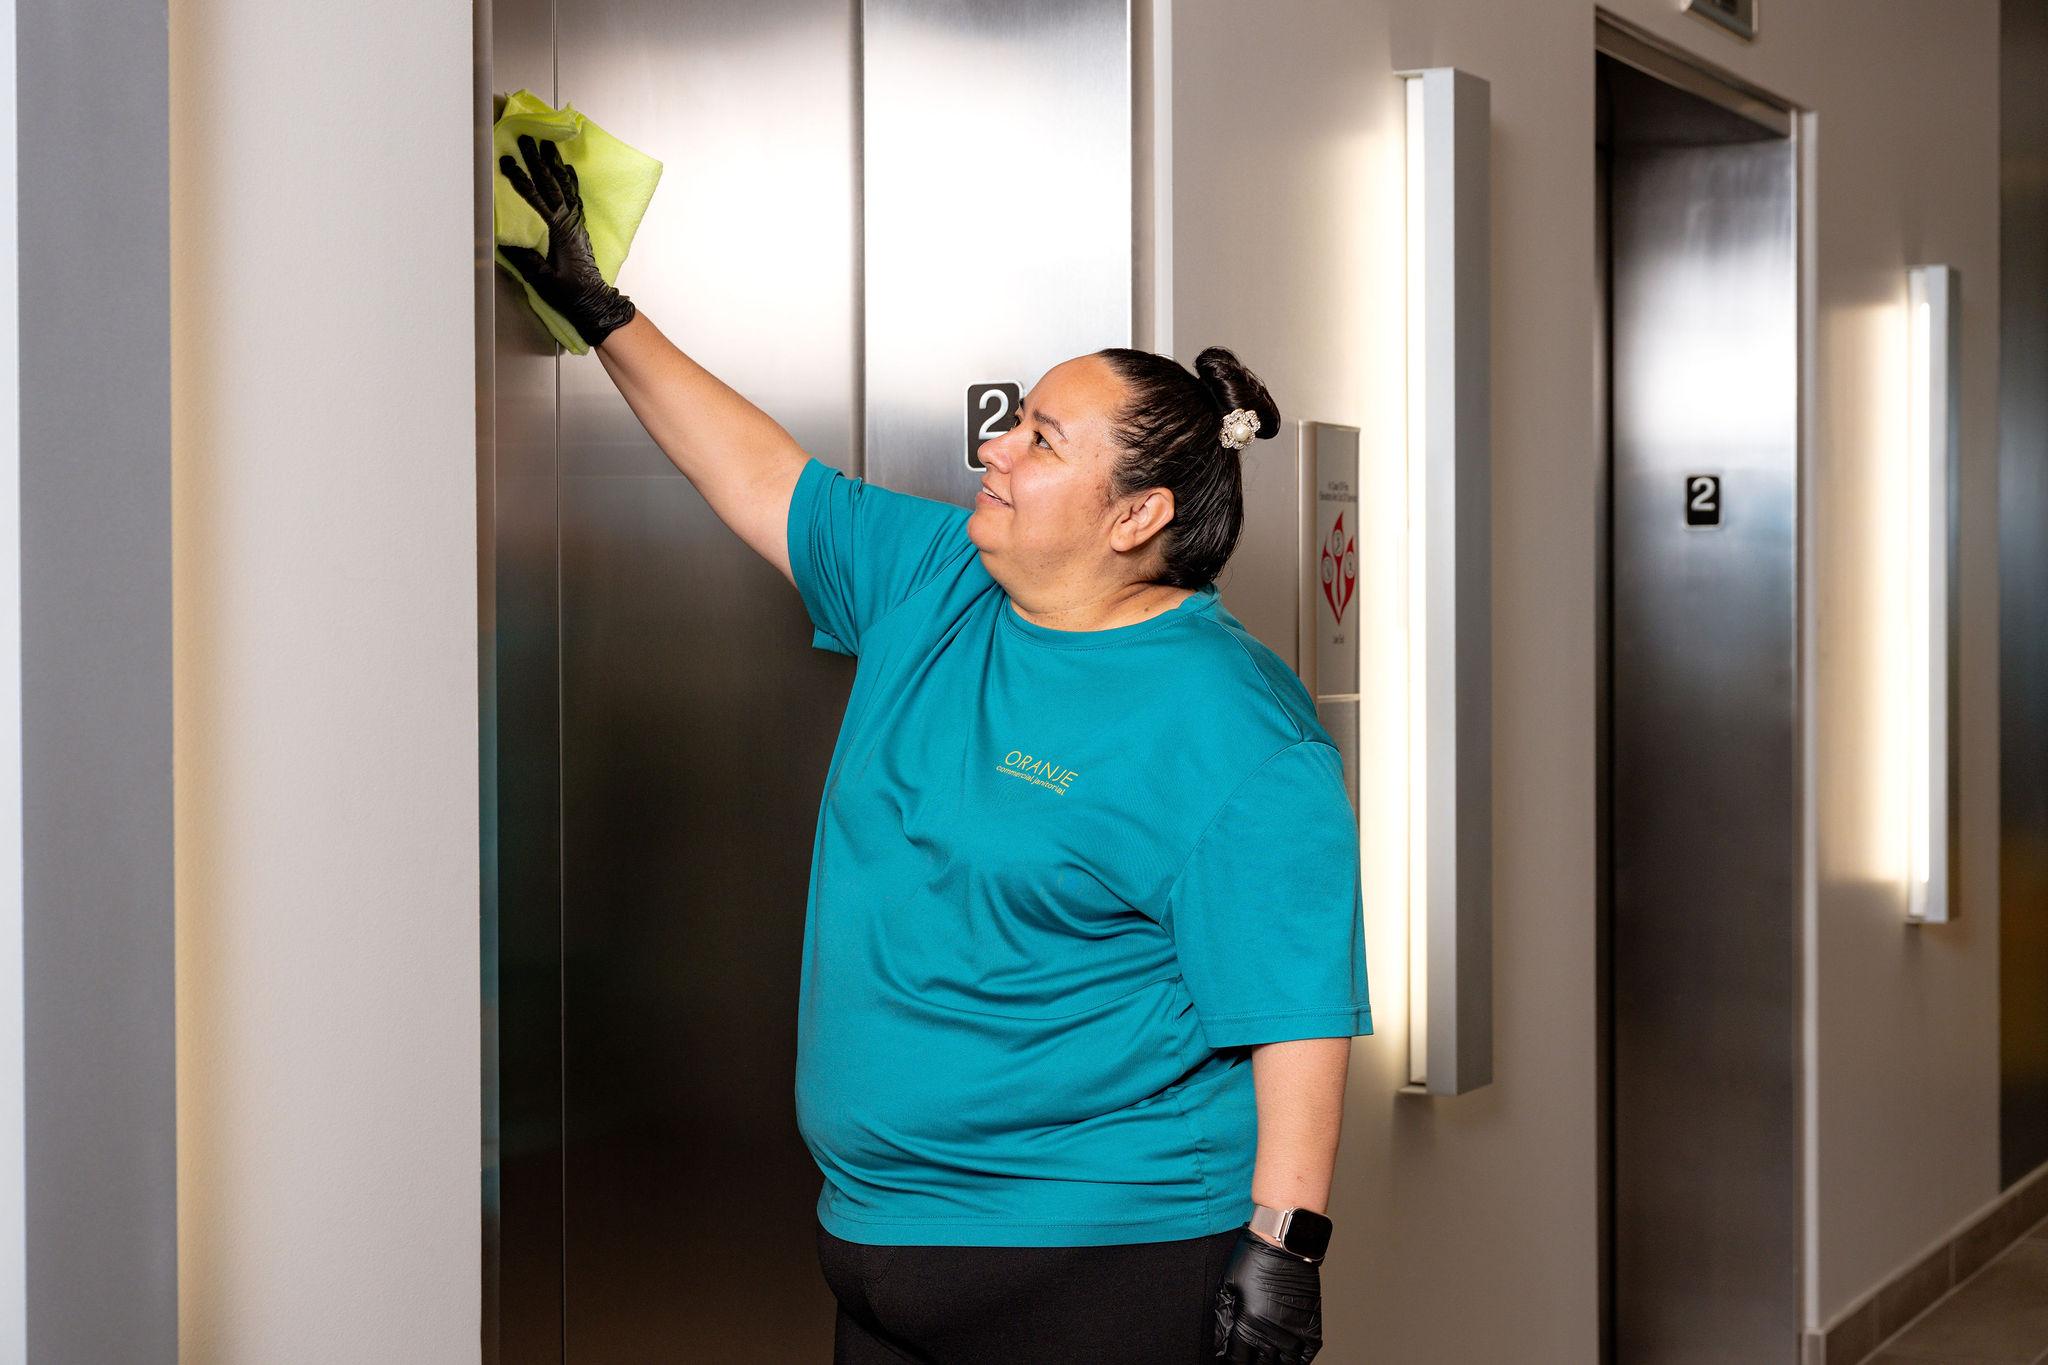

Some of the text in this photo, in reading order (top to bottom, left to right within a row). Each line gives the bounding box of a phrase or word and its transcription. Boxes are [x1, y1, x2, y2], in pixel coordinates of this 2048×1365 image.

[979, 389, 1008, 439] 2
[1691, 477, 1716, 510] 2
[996, 765, 1066, 796] commercial janitorial
[1005, 750, 1078, 788] ORANJE
